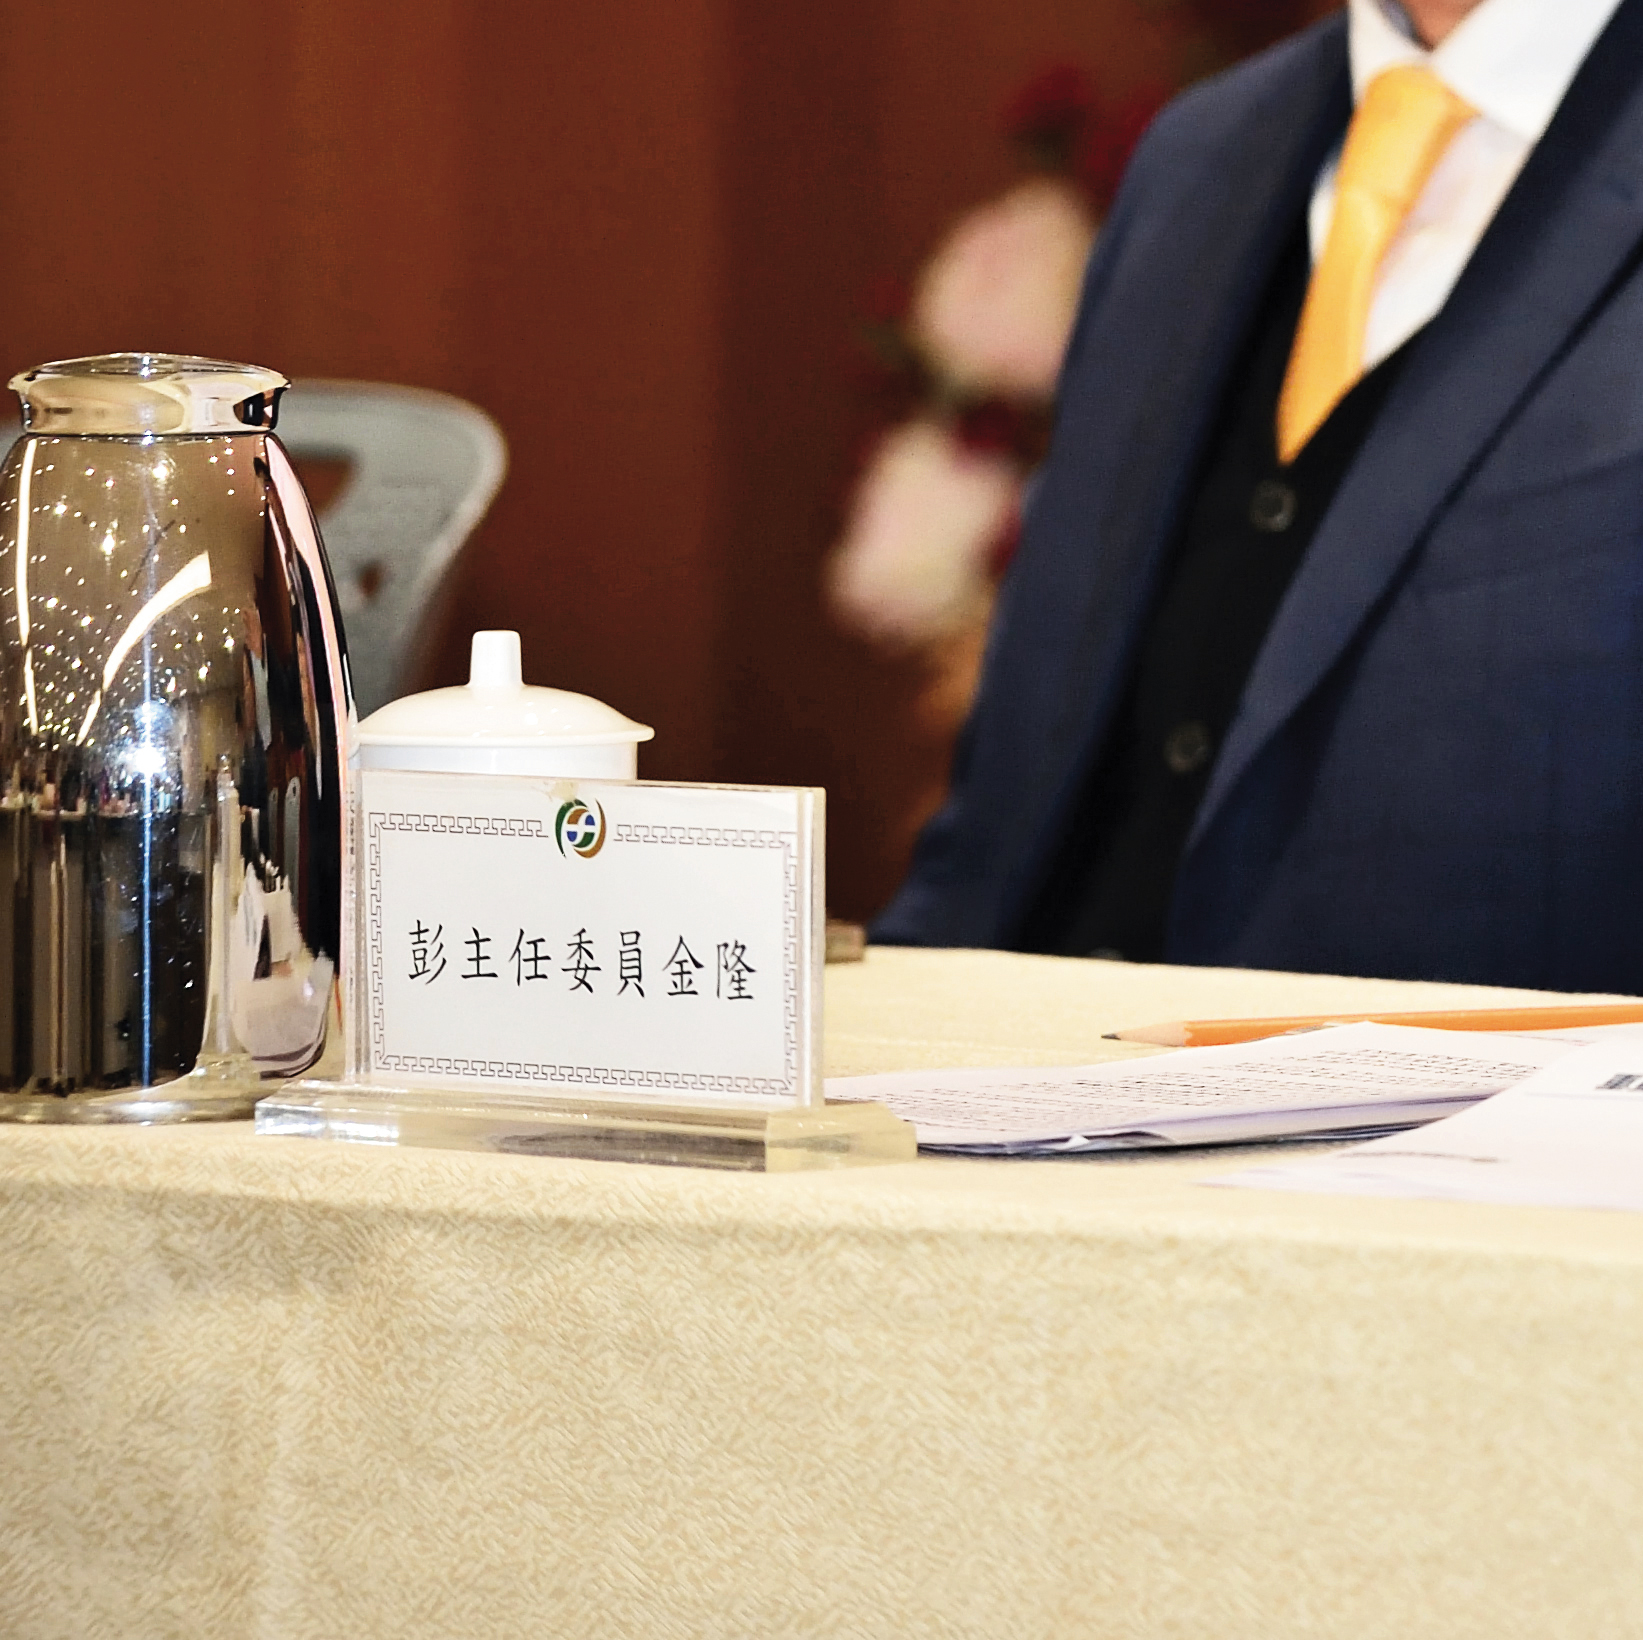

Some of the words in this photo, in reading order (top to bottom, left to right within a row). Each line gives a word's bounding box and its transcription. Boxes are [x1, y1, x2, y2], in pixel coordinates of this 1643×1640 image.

[407, 918, 757, 1001] 彭主任委員金隆
